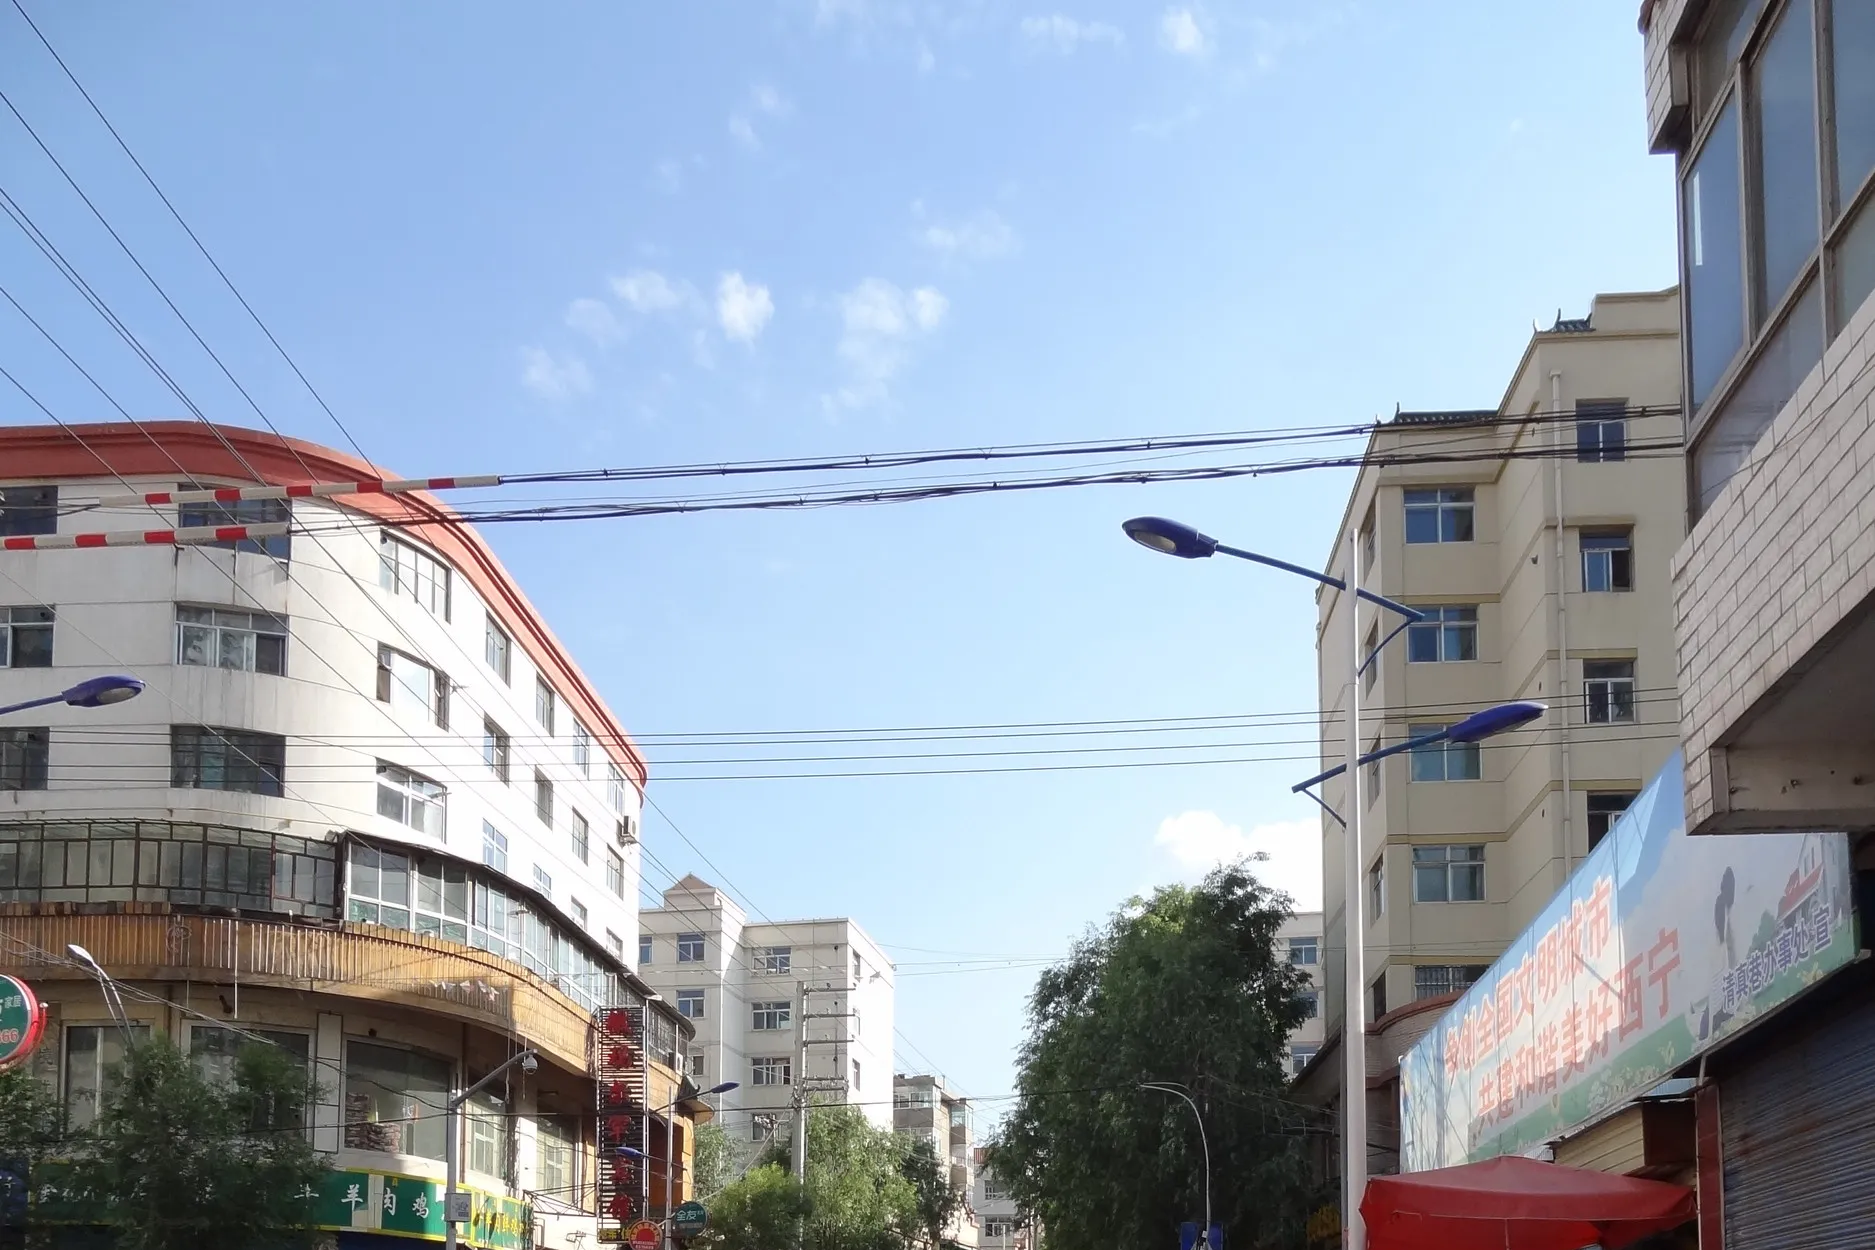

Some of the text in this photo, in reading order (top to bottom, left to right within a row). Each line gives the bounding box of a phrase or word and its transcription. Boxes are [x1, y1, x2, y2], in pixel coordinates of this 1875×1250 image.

[1444, 876, 1613, 1082] 争创全国文明城市
[1478, 927, 1681, 1137] 共建和谐美好西宁
[1722, 904, 1832, 1012] 清真巷办事处宣
